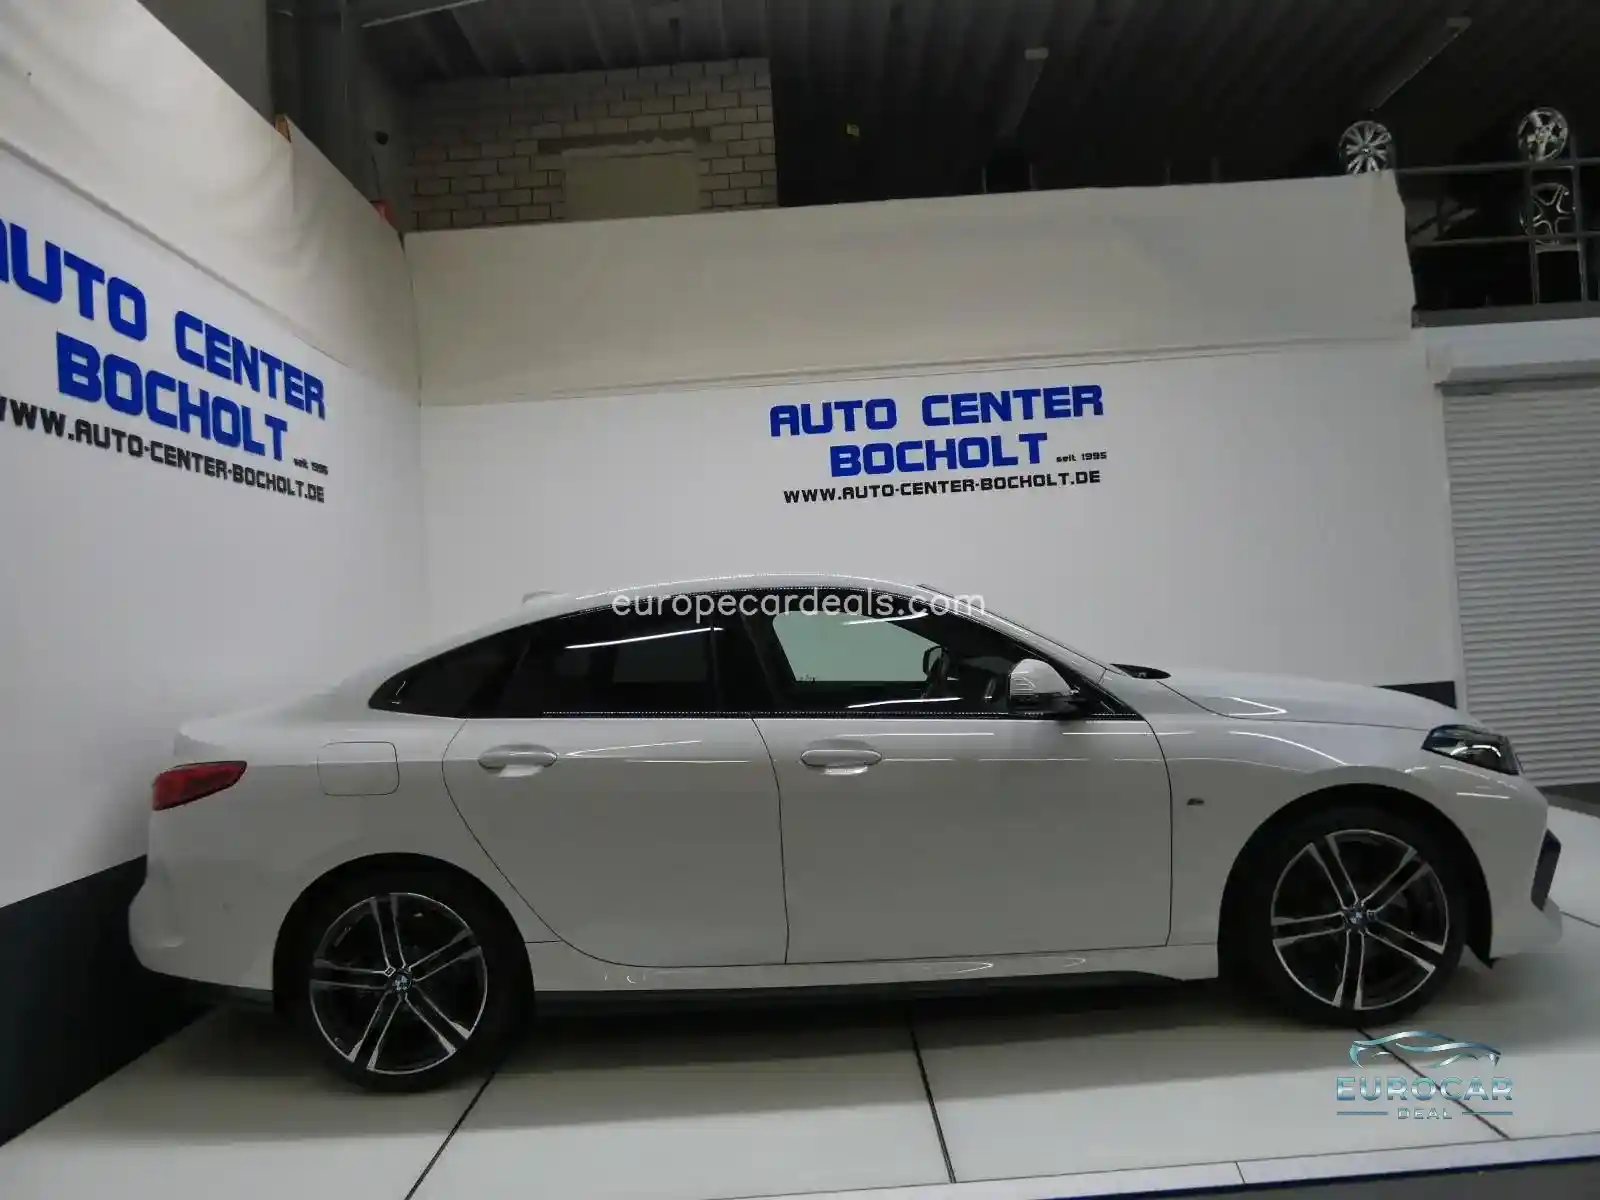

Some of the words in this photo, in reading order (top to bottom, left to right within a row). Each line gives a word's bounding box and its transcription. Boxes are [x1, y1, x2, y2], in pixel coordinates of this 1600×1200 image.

[0, 218, 147, 342] UTO
[174, 310, 326, 420] CENTER
[56, 330, 288, 460] BOCHOLT
[769, 397, 898, 437] AUTO
[921, 384, 1104, 427] CENTER
[0, 396, 325, 503] WW.AUTO-CENTER-BOCHOLT.DE
[783, 470, 1101, 504] WWW.AUTO-CENTER-BOCHOLT.DE
[829, 432, 1048, 478] BOCHOLT
[1056, 454, 1077, 463] seit
[1081, 451, 1107, 461] 1995
